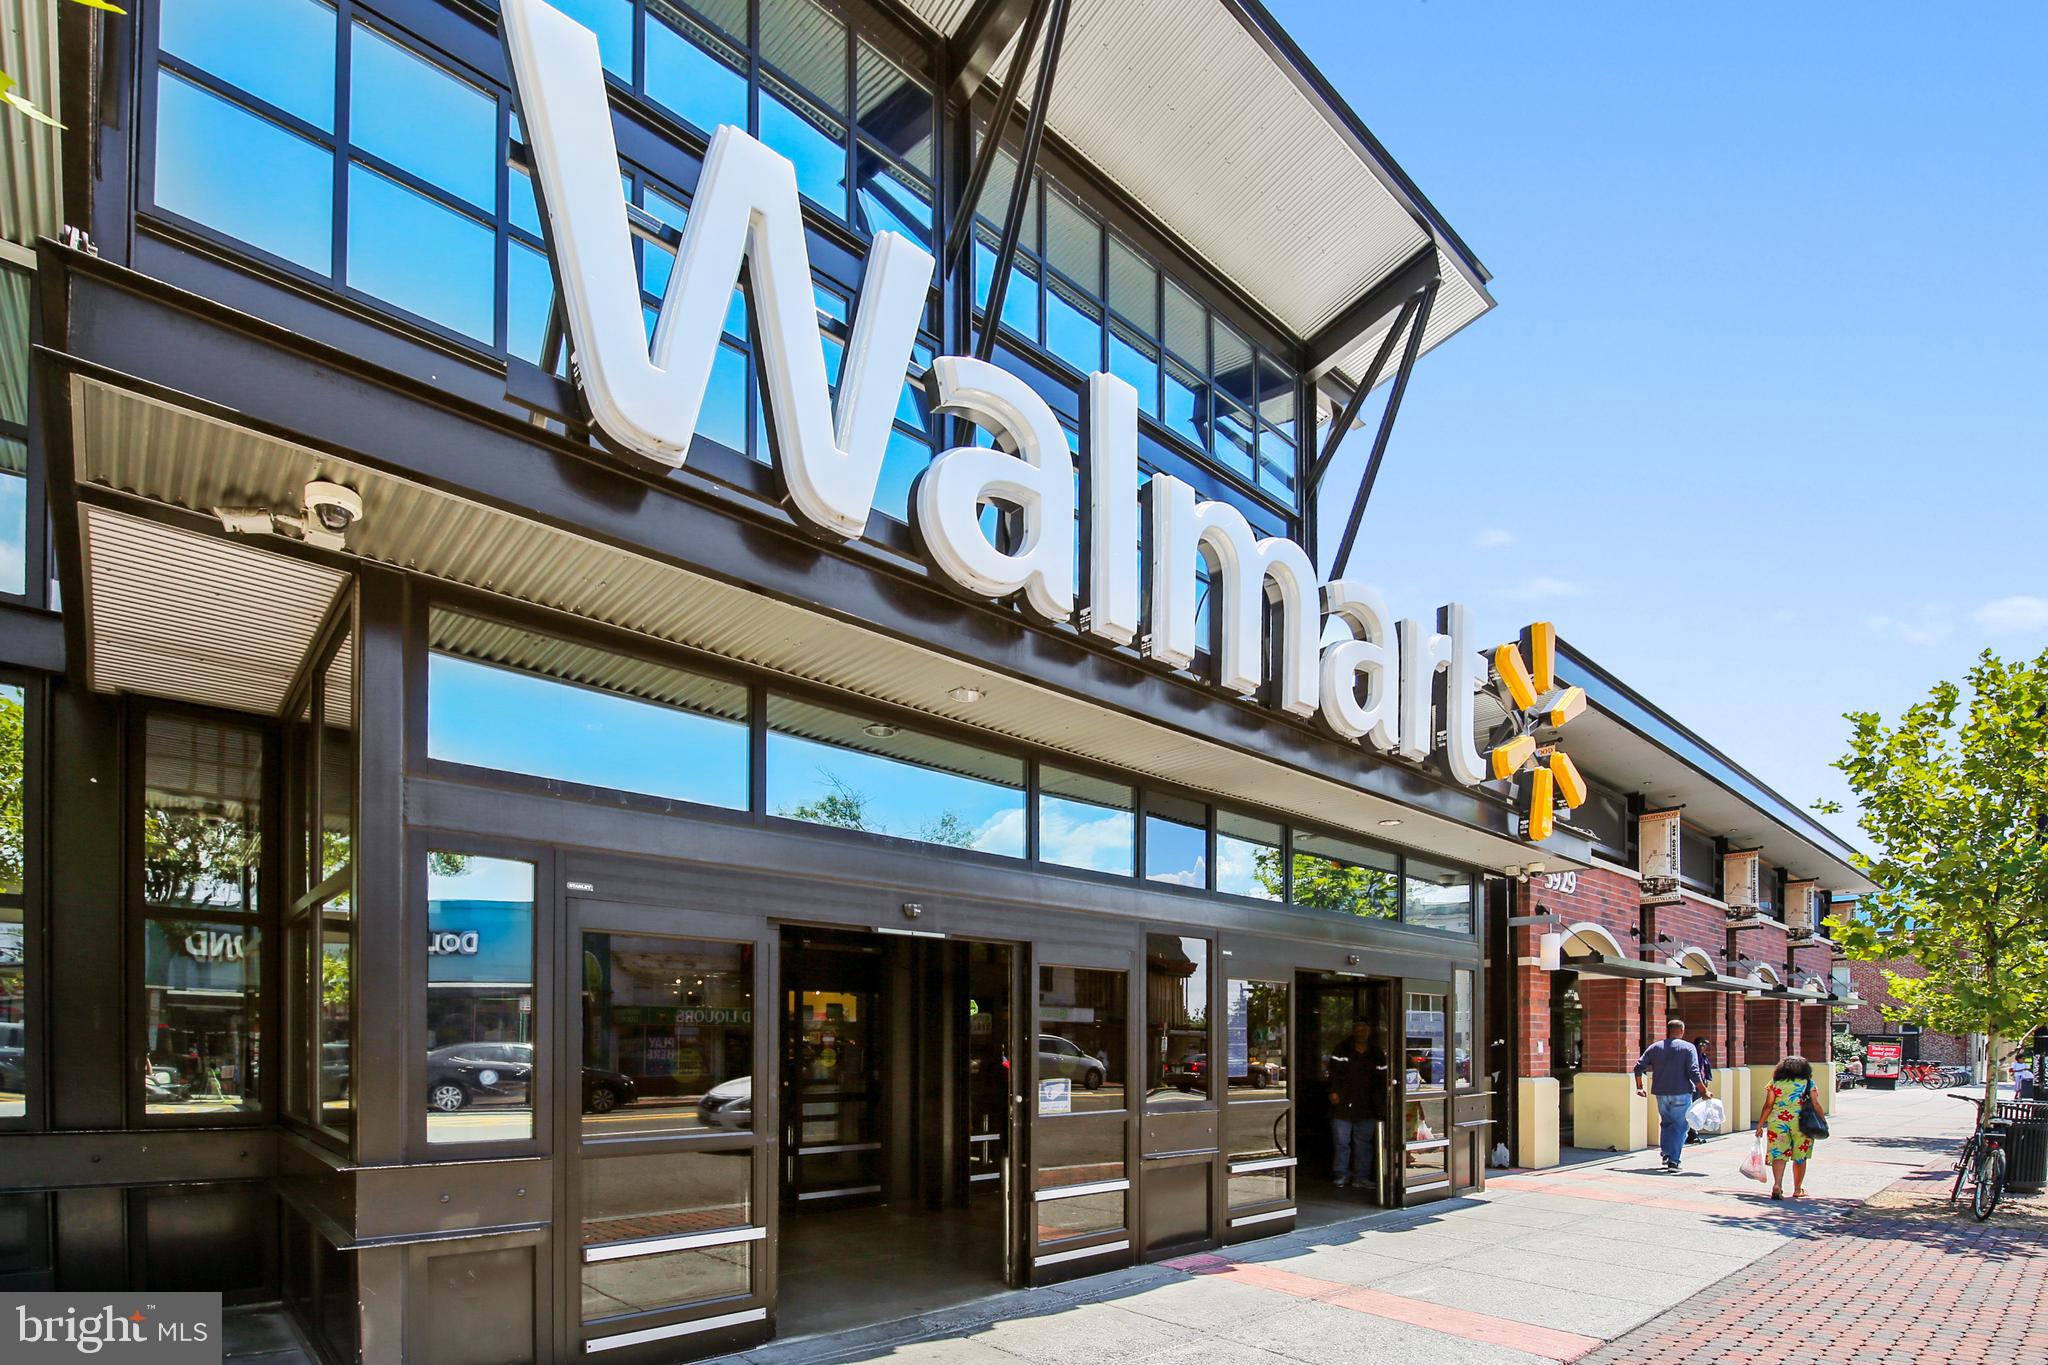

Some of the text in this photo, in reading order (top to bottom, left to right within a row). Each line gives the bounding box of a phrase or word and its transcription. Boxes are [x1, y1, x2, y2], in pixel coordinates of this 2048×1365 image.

[499, 0, 1488, 787] Walmart
[1640, 811, 1679, 821] RIGHTWOOD
[1640, 895, 1680, 904] RIGHTWOOD
